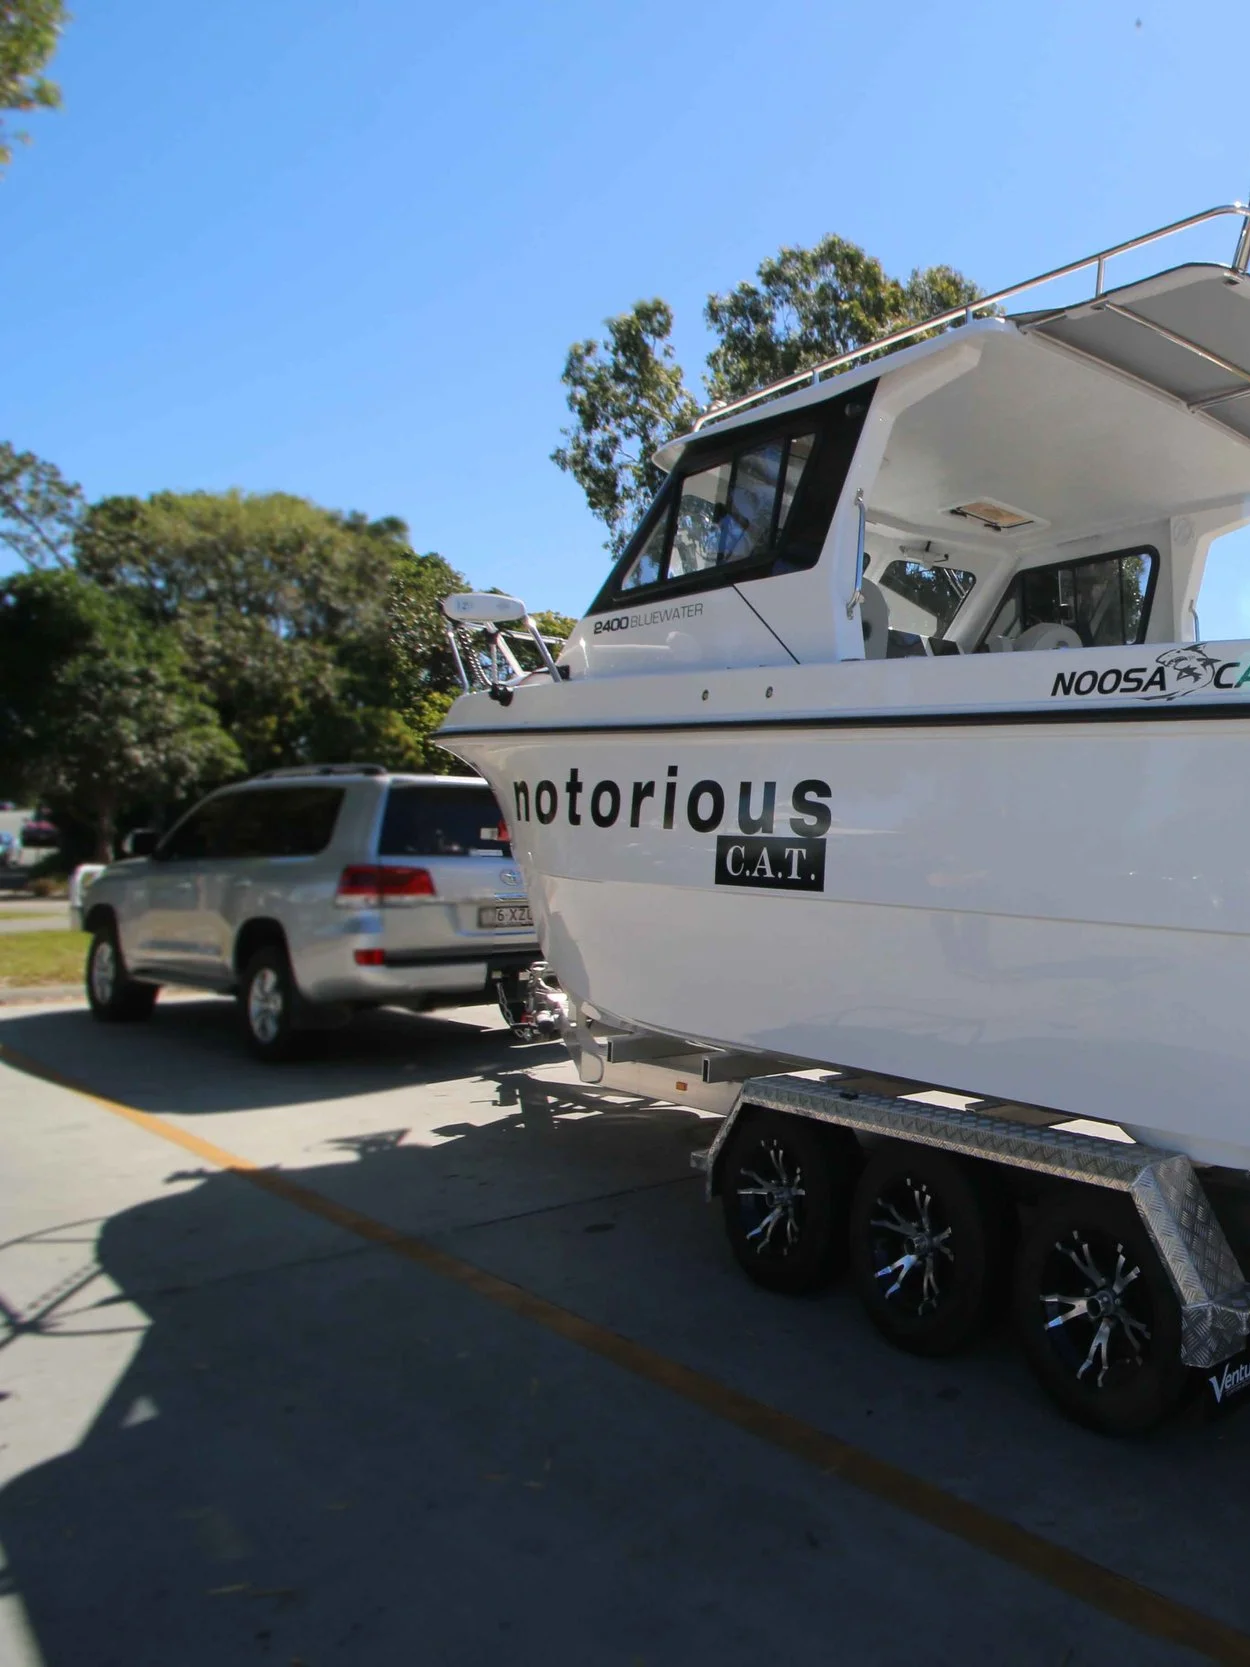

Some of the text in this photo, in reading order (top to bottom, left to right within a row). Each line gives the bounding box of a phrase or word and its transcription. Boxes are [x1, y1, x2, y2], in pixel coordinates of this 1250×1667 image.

[594, 603, 704, 634] 2400 BLUEWATER
[1051, 666, 1166, 697] NOOSA
[513, 766, 832, 838] notorious
[725, 845, 816, 881] C.A.T.
